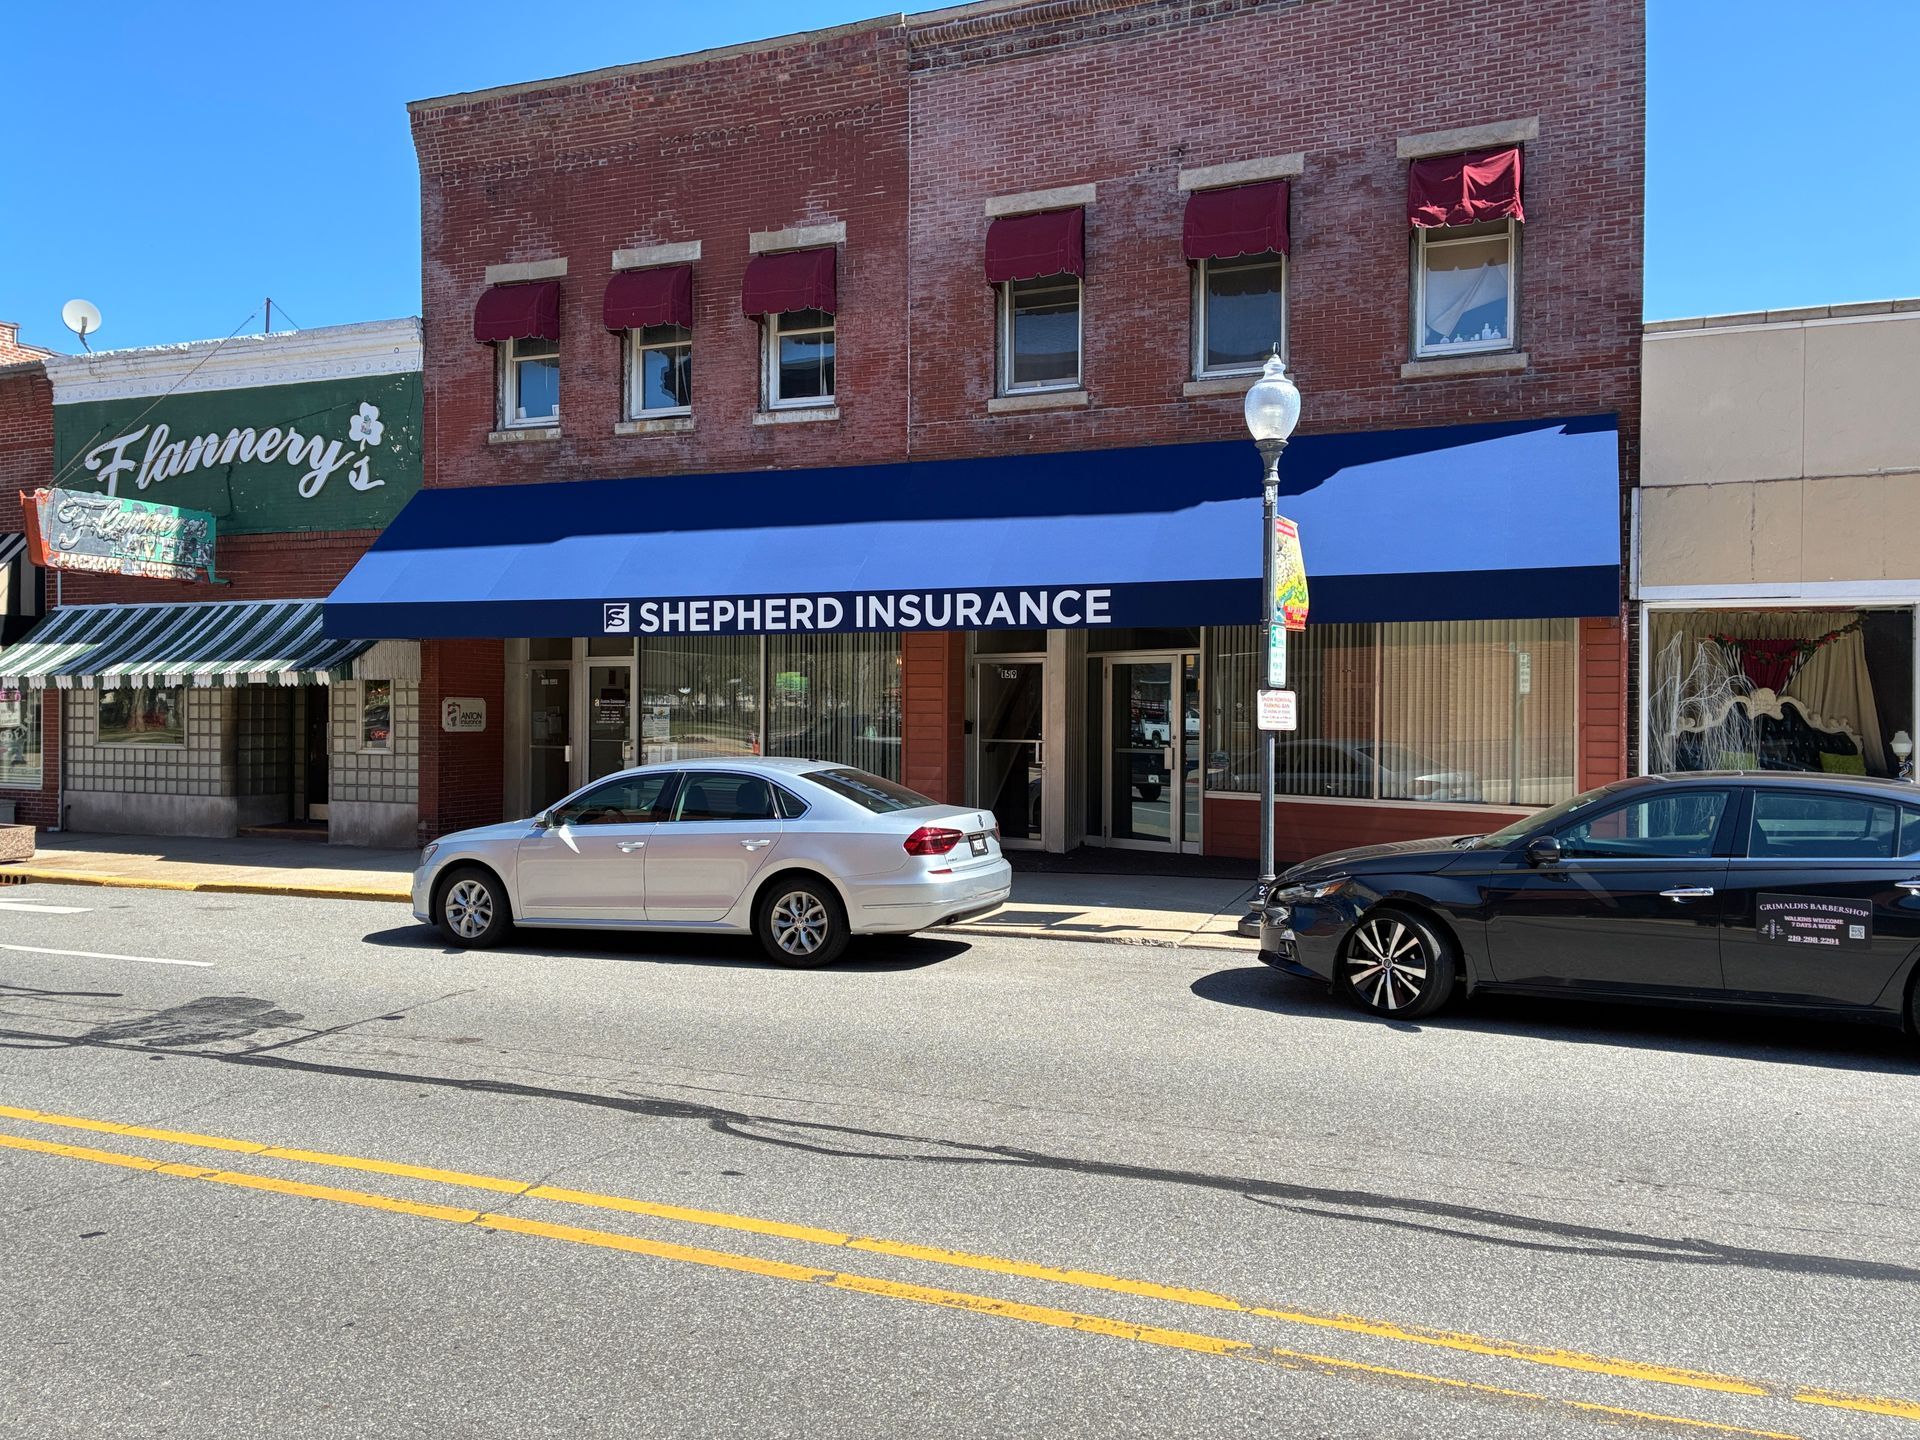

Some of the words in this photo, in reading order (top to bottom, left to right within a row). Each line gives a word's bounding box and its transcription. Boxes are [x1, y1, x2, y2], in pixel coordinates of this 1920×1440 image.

[85, 408, 385, 499] Flannery's
[639, 597, 844, 633] SHEPHERD
[855, 589, 1112, 628] INSURANCE
[460, 711, 483, 720] ANTON
[1759, 902, 1808, 911] GRIMALDIS
[1810, 903, 1869, 917] BARBERSHOP
[1812, 917, 1845, 925] WELCOME
